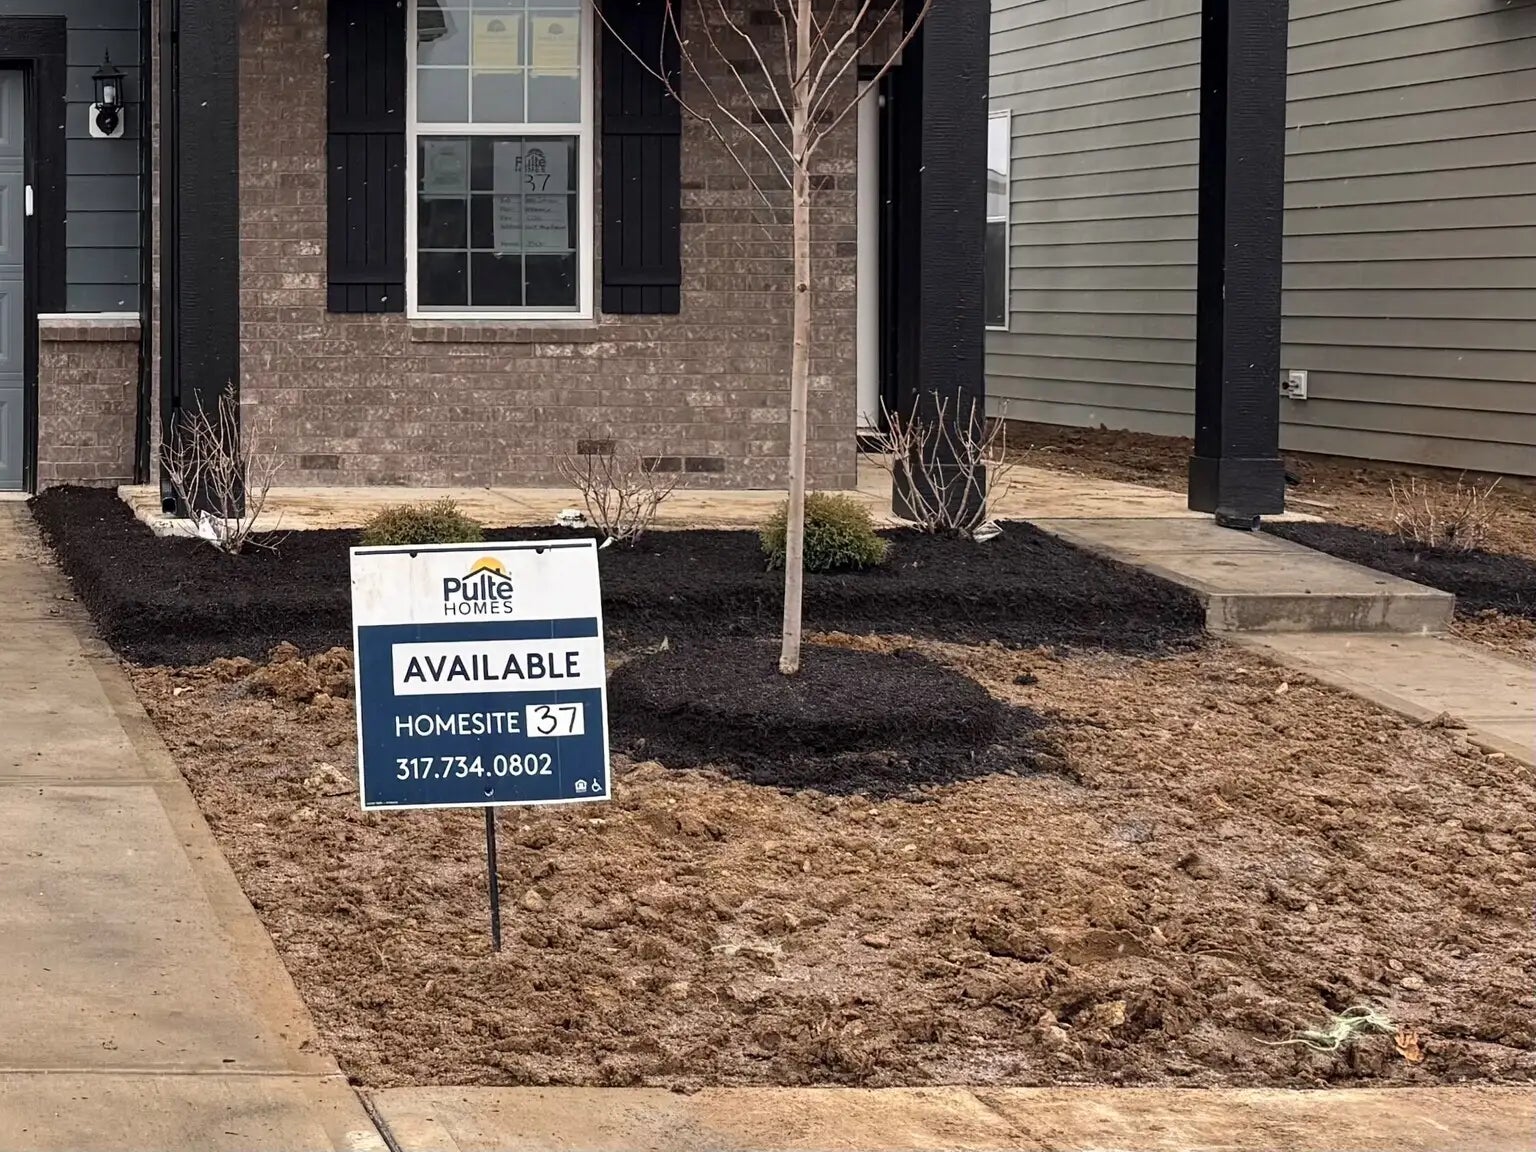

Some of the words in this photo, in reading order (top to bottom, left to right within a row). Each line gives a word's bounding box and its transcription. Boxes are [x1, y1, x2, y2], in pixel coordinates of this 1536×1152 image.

[443, 573, 514, 602] Pulte
[444, 600, 513, 616] HOMES
[403, 651, 581, 683] AVAILABLE
[395, 712, 520, 737] HOMESITE
[534, 705, 577, 735] 37
[396, 753, 553, 780] 317.734.0802
